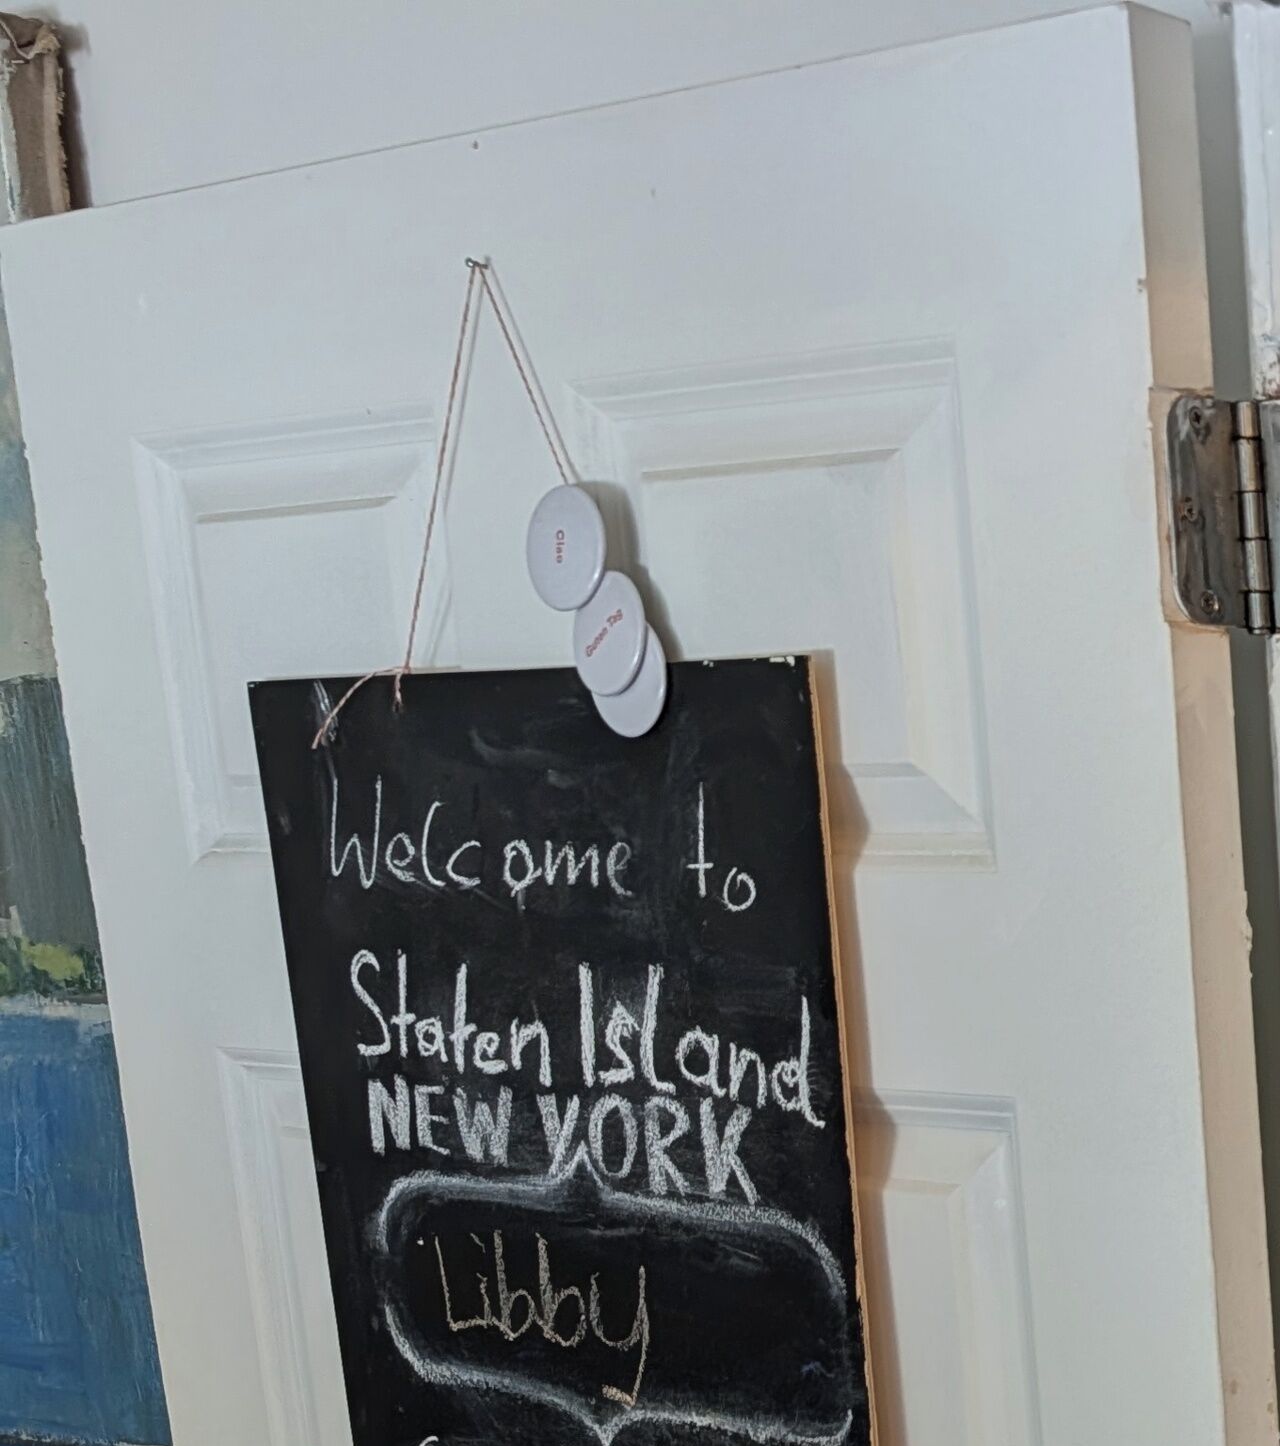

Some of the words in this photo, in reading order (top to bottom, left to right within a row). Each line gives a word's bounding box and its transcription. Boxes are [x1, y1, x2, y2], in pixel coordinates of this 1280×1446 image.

[327, 775, 634, 897] Welcome
[687, 781, 757, 912] to
[350, 949, 552, 1087] Staten
[580, 962, 826, 1128] Island
[366, 1073, 513, 1167] NEW
[535, 1092, 757, 1206] YORK
[434, 1230, 649, 1407] Libby
